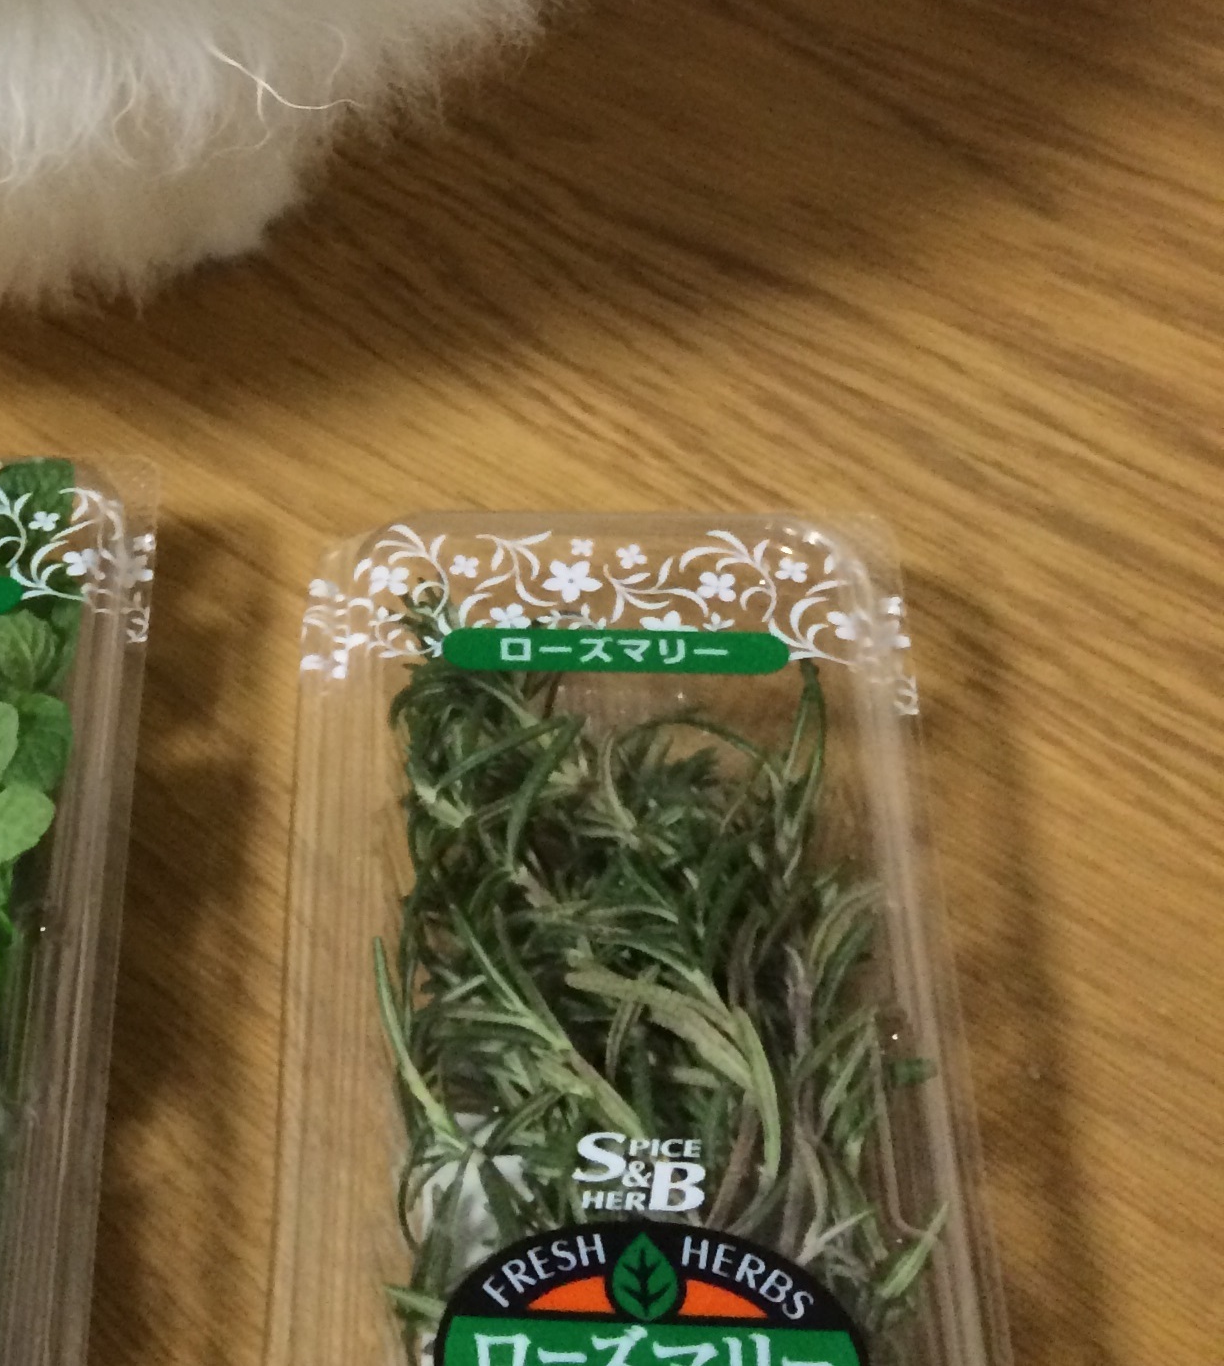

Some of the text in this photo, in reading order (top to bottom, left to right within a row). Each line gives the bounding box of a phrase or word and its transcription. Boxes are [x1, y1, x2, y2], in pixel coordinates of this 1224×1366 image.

[500, 636, 729, 665] ローズマリー
[482, 1233, 815, 1321] FRESH HERBS
